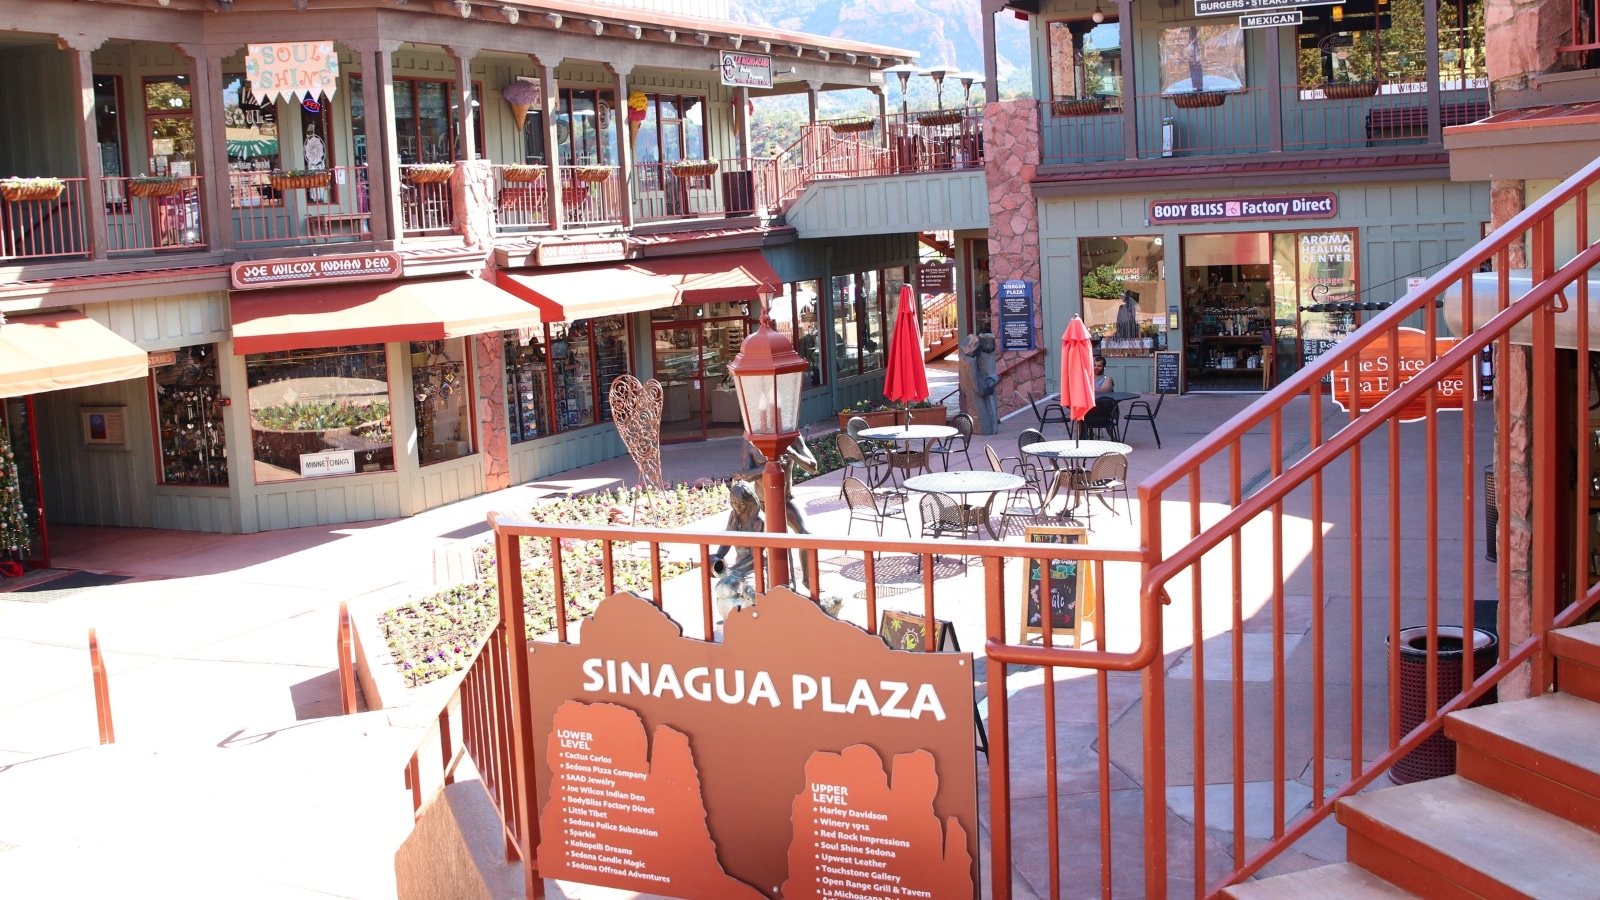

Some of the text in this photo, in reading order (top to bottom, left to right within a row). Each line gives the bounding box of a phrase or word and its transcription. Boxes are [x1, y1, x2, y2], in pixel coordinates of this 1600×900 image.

[1200, 0, 1244, 11] BURGERS
[1247, 14, 1295, 26] MEXICAN
[261, 44, 321, 65] SOUL
[260, 68, 331, 89] SHINE
[1154, 197, 1331, 218] BODY BLISS Factory Direct
[1302, 234, 1350, 244] AROMA
[1302, 245, 1350, 254] HEALING
[1302, 254, 1351, 263] CENTER
[243, 257, 390, 277] JOE WILCOX INDIAN DEN
[1377, 356, 1425, 372] Sice
[582, 657, 947, 722] SINAGUA PLAZA
[557, 729, 593, 741] LOWER
[561, 739, 591, 750] LEVEL
[565, 752, 612, 764] Cactus Carlos
[565, 763, 647, 781] Sedona Pizza Company
[566, 774, 616, 788] SAAD Jewelry
[566, 785, 645, 802] Joe Wilcox Indian Den
[811, 783, 848, 796] UPPER
[567, 796, 655, 814] BodyBliss Factory Direct
[813, 793, 848, 806] LEVEL
[568, 807, 608, 819] Little Tibet
[820, 806, 888, 821] Harley Davidson
[568, 818, 659, 837] Sedona Police Substation
[820, 818, 870, 831] Winery 1912
[569, 828, 596, 839] Sparkle
[820, 830, 910, 848] Red Rock Impressions
[570, 840, 633, 855] Kokopelli Dreams
[820, 841, 896, 858] Soul Shine Sedona
[571, 850, 646, 869] Sedona Candle Magic
[821, 853, 887, 869] Upwest Leather
[571, 861, 670, 883] Sedona Offroad Adventures
[821, 864, 901, 883] Touchstone Gallery
[822, 877, 931, 898] Open Range Grill & Tavern
[822, 888, 834, 897] La
